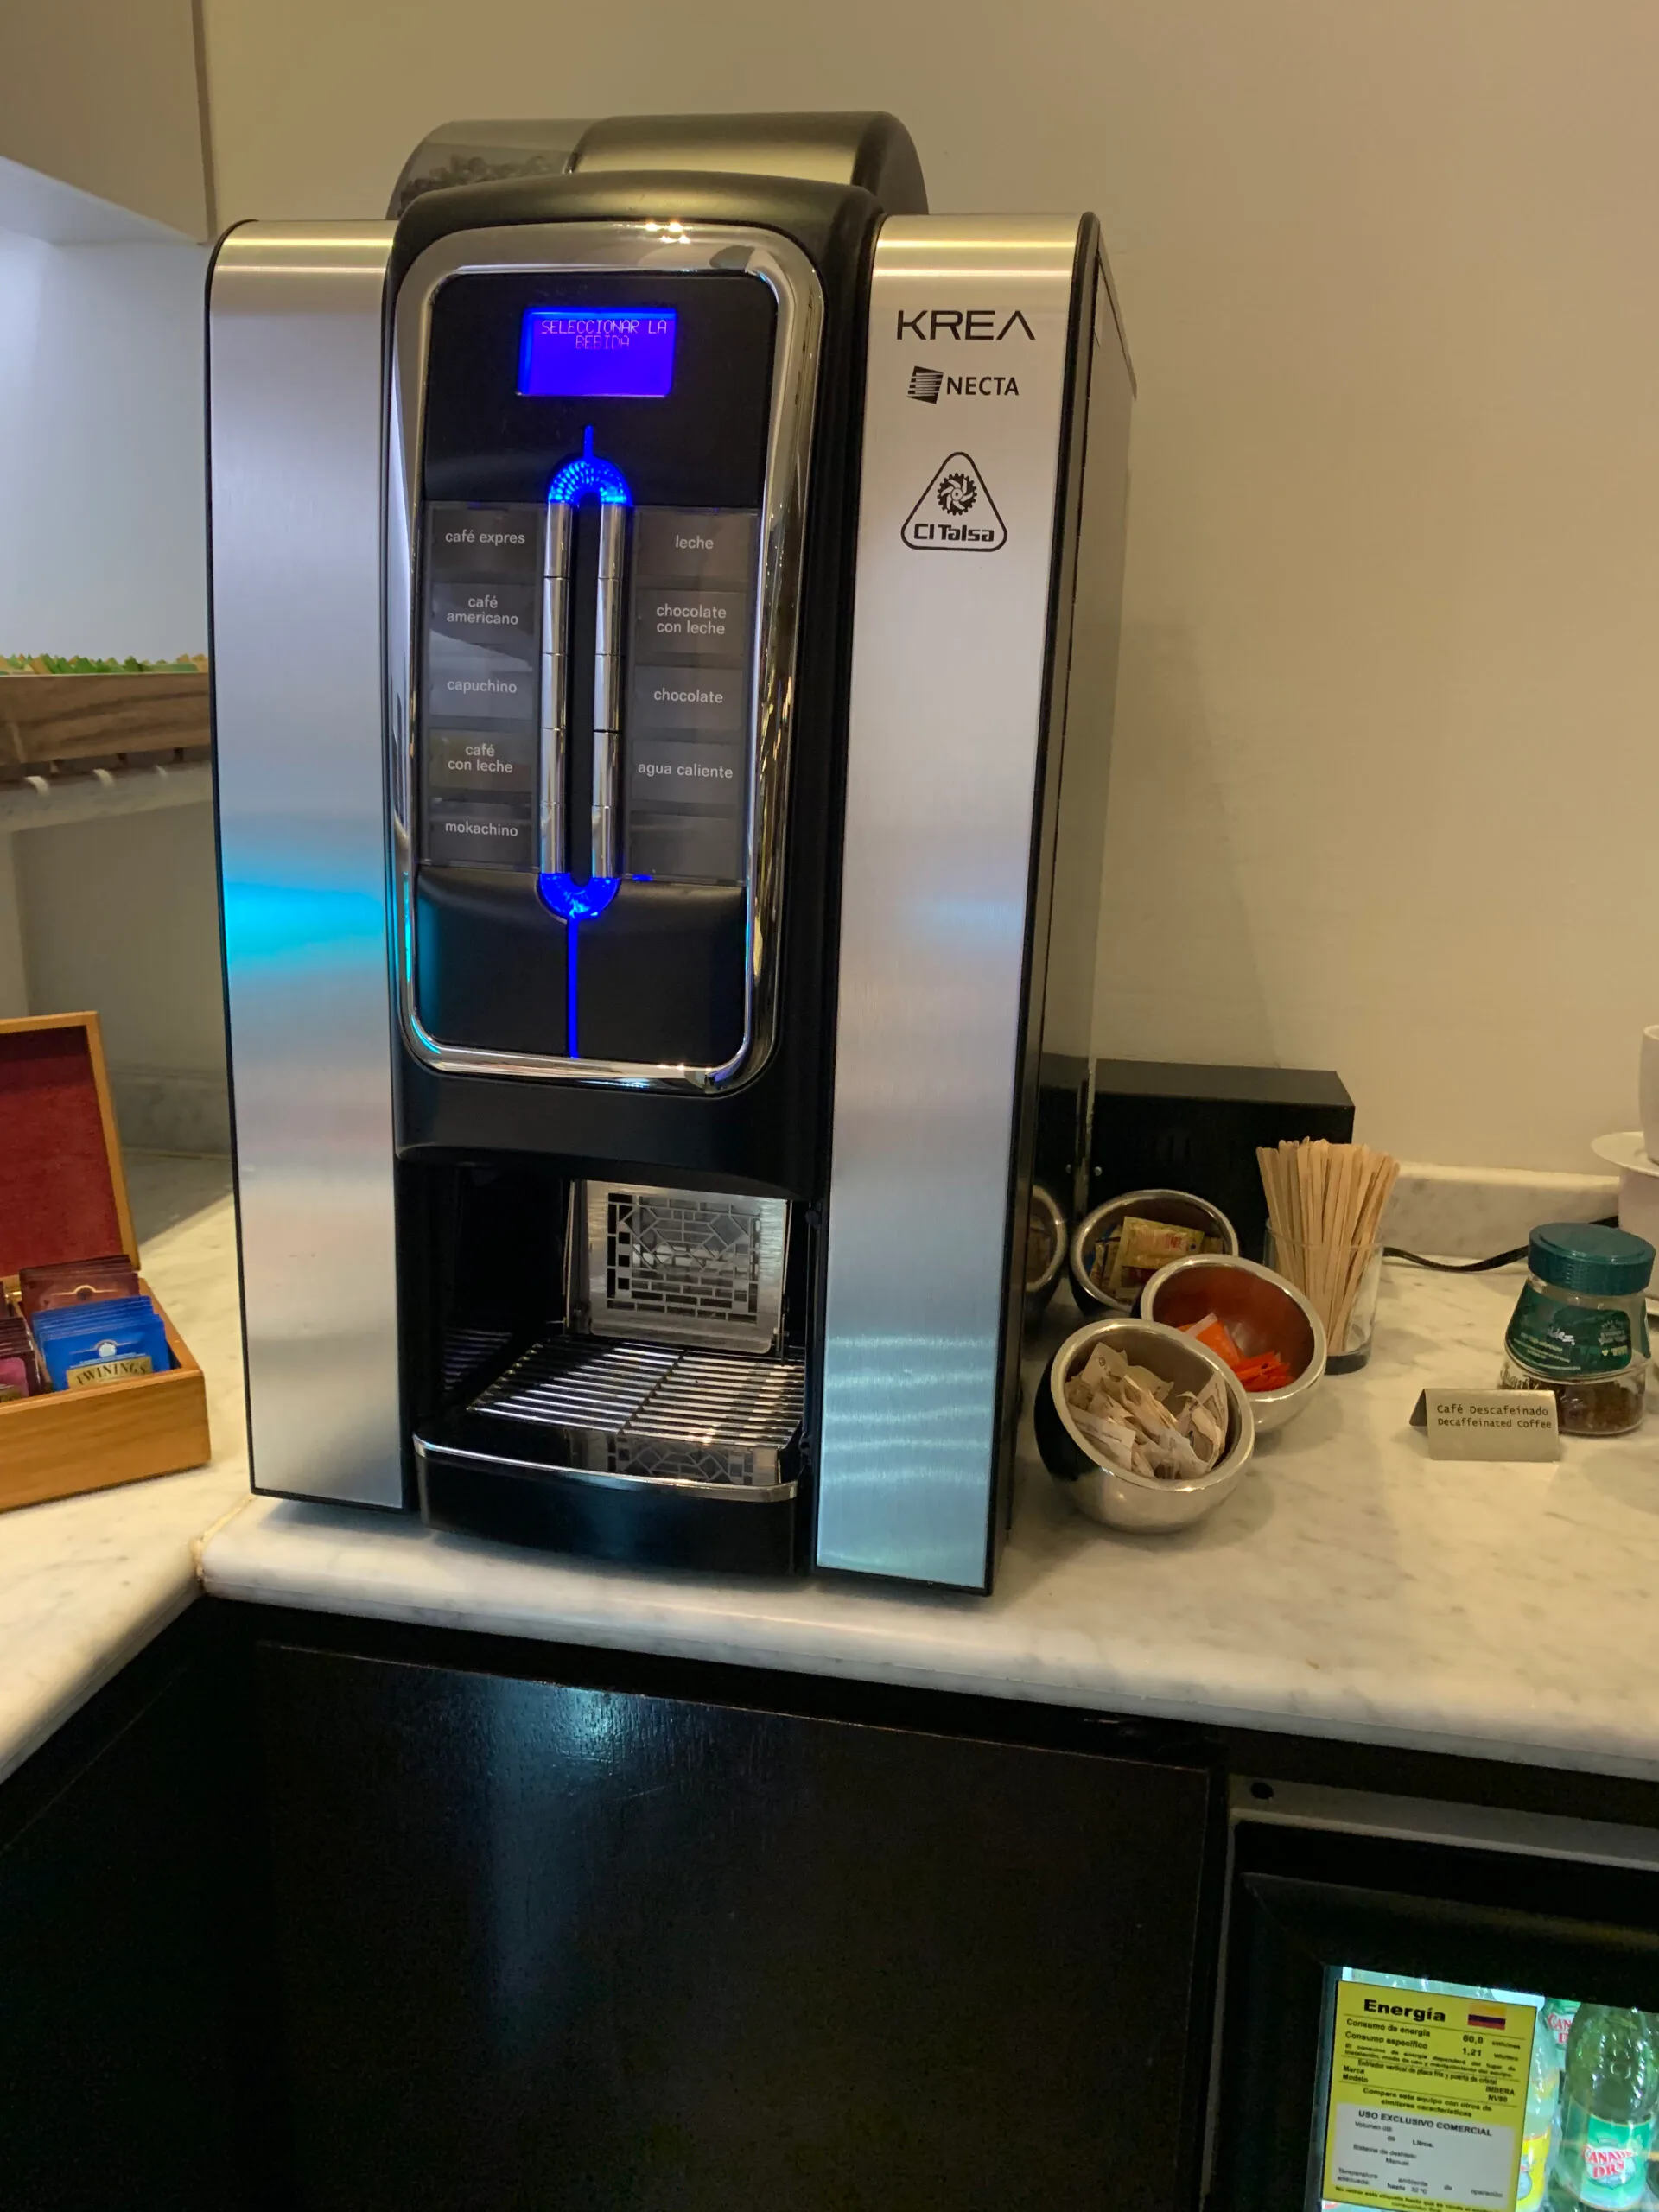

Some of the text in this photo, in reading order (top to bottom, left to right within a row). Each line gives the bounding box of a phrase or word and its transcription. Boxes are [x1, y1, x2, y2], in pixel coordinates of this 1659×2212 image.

[541, 320, 667, 334] SELECCIONAR LA
[896, 309, 1036, 340] KREA
[575, 334, 630, 350] BEBIDA
[946, 376, 1020, 396] NECTA
[445, 529, 525, 546] café expres
[675, 535, 714, 550] leche
[467, 594, 499, 608] café
[446, 611, 518, 626] americano
[656, 603, 727, 619] chocolate
[657, 620, 725, 634] con leche
[447, 679, 518, 694] capuchino
[653, 688, 723, 703] chocolate
[465, 743, 495, 757] café
[448, 759, 513, 773] con leche
[638, 763, 734, 779] agua caliente
[445, 821, 518, 837] mokachino
[75, 1363, 146, 1386] TWININGS
[1437, 1403, 1549, 1416] Café Descafeinado
[1438, 1417, 1553, 1429] Decaffeinated Coffee
[1363, 1999, 1446, 2022] Energía
[1346, 2018, 1386, 2031] Consumo
[1400, 2026, 1431, 2037] energía
[1548, 2013, 1572, 2030] CAN
[1344, 2031, 1428, 2050] Consumo específico
[1342, 2073, 1369, 2083] Modelo
[1343, 2065, 1365, 2075] Marca
[1363, 2087, 1397, 2099] Compare
[1399, 2092, 1414, 2101] este
[1416, 2095, 1442, 2105] equipo
[1460, 2101, 1480, 2111] otros
[1381, 2099, 1415, 2109] similares
[1358, 2109, 1492, 2137] USO EXCLUSIVO COMERCIAL
[1592, 2161, 1624, 2178] DRY
